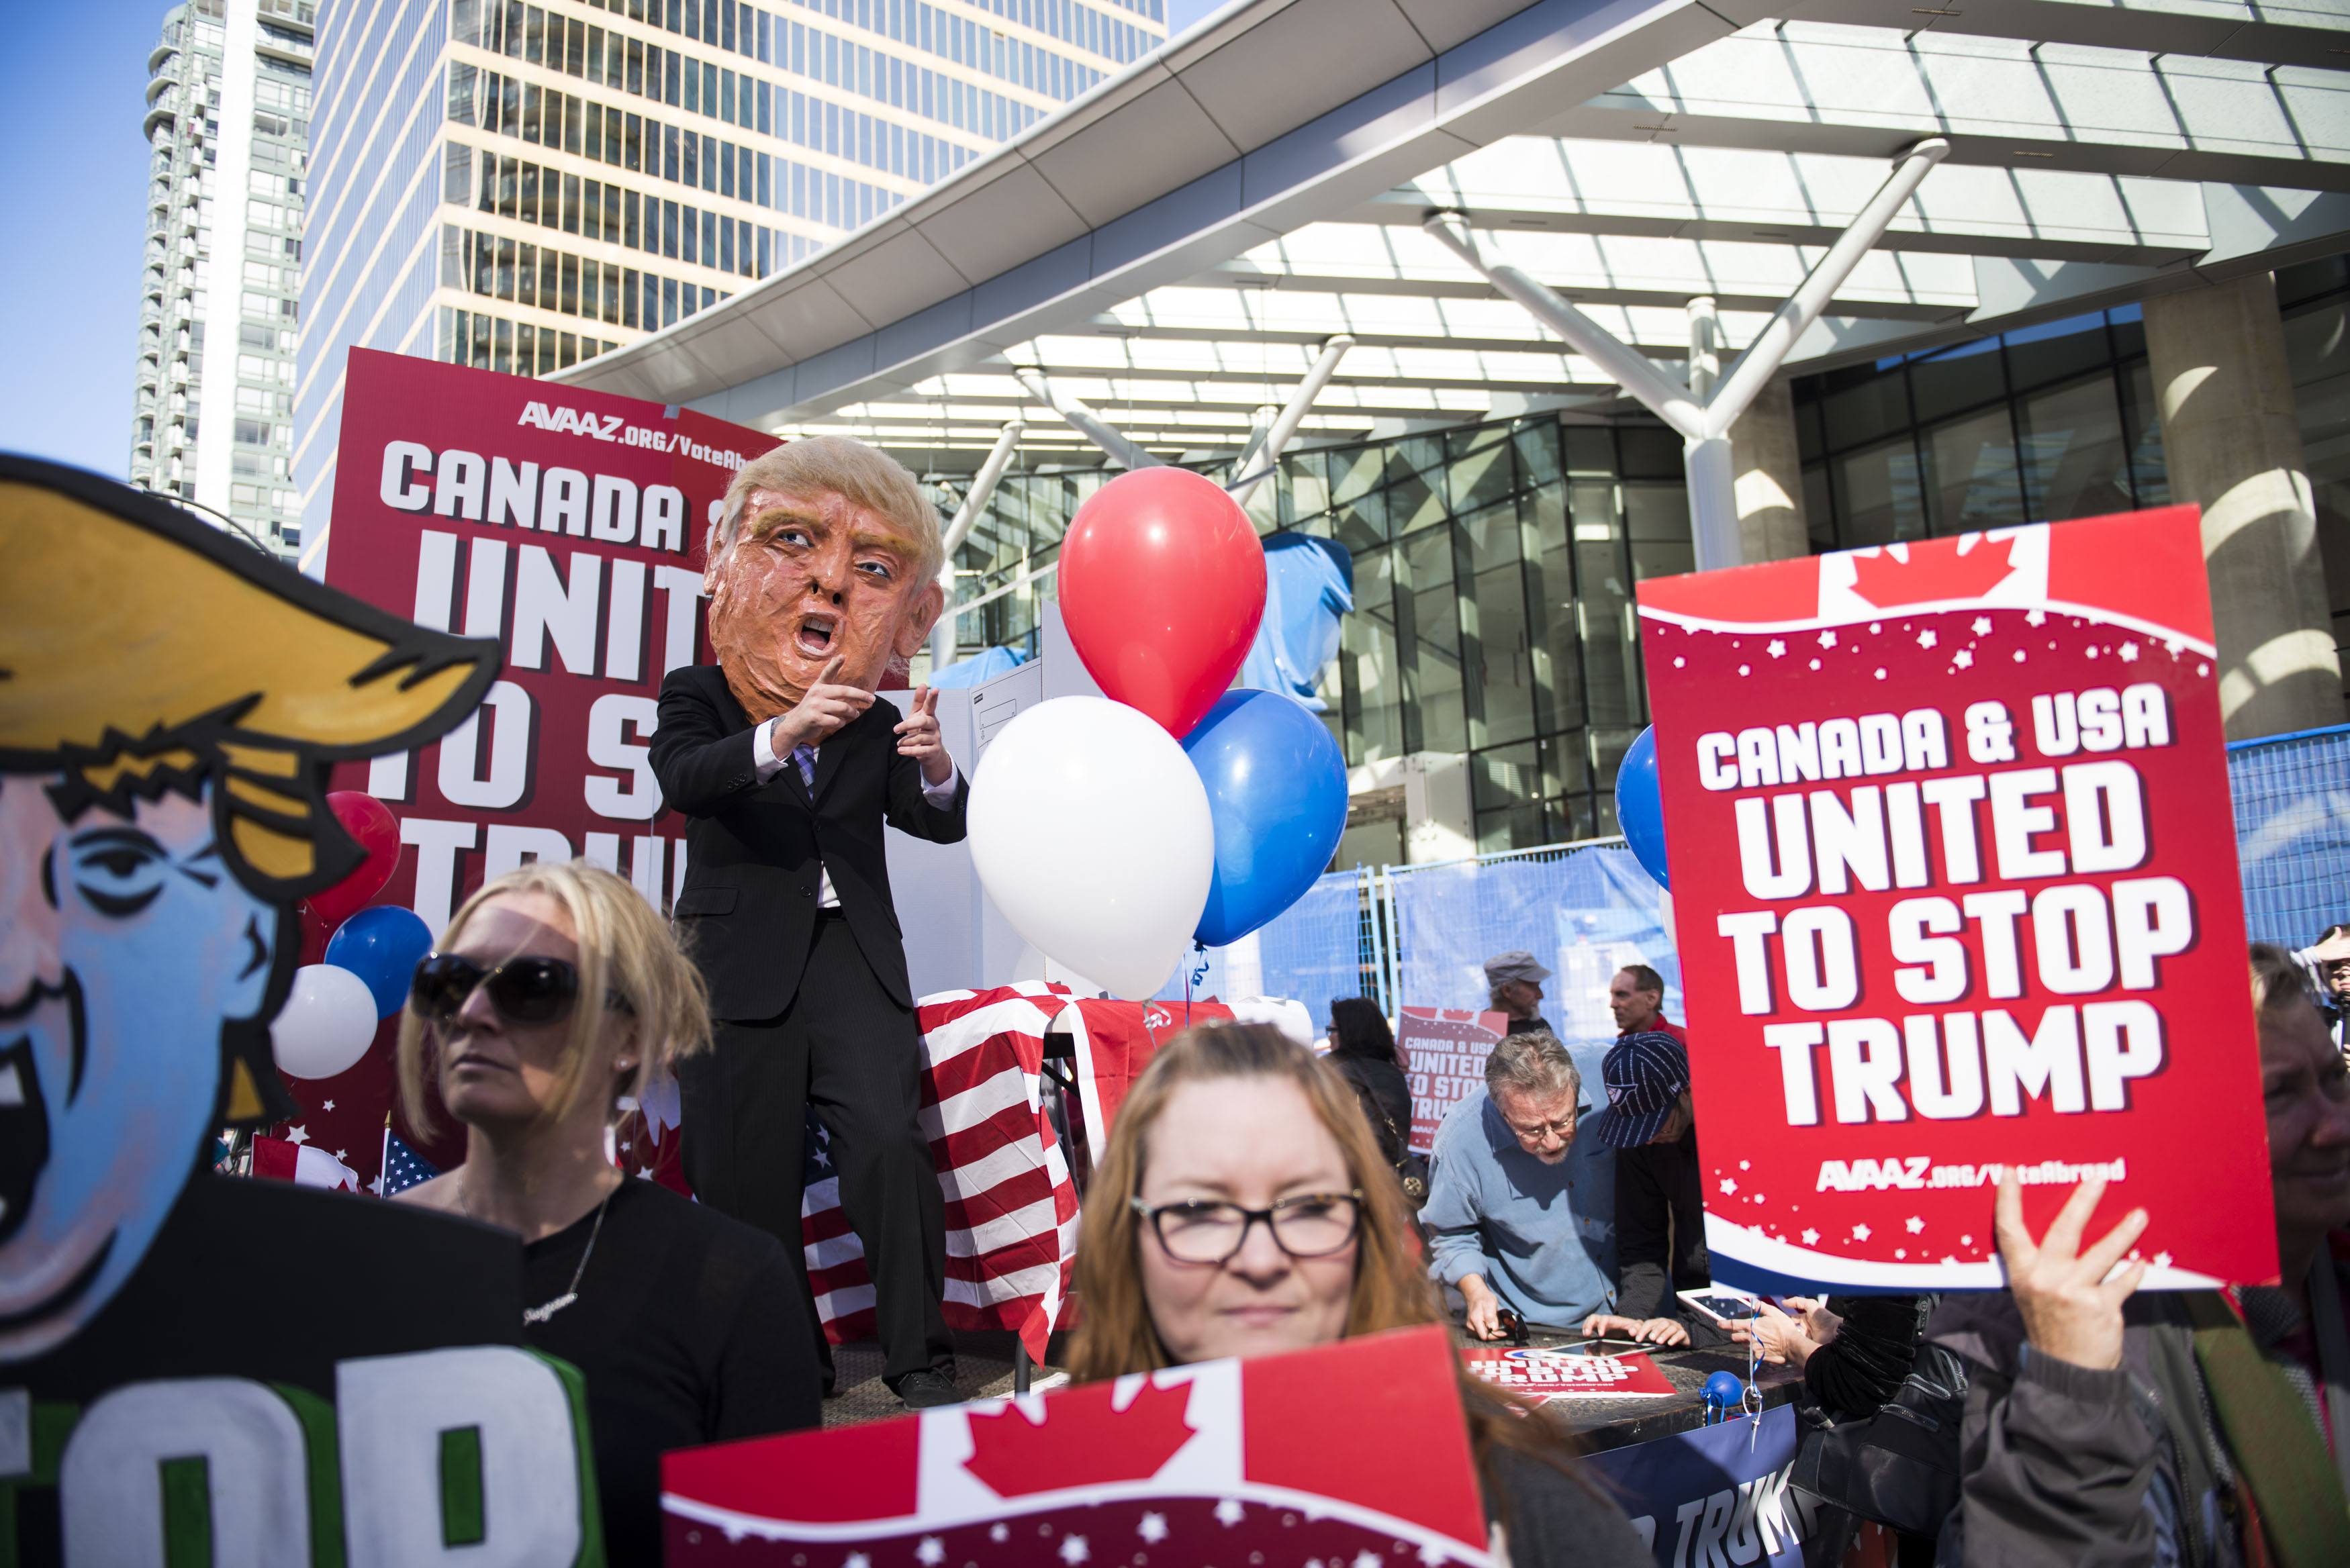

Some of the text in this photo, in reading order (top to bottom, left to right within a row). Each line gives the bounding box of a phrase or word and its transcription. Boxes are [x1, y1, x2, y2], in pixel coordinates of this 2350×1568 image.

[518, 401, 749, 471] AVAAZ.ORG/VoteAb
[380, 440, 684, 552] CANADA
[414, 530, 713, 681] UNIT
[1697, 683, 2170, 791] CANADA & USA
[1734, 759, 2147, 900] UNITED
[1717, 876, 2193, 1015] TO STOP
[1405, 1036, 1454, 1052] CANADA
[1457, 1041, 1466, 1054] &
[1409, 1050, 1487, 1078] UNITED
[1763, 999, 2164, 1127] TRUMP
[1411, 1097, 1454, 1121] TRU
[1433, 1076, 1484, 1099] STO
[1816, 1156, 2125, 1193] AVAAZ.ORG/VteAbroad
[1525, 1365, 1639, 1375] STOP
